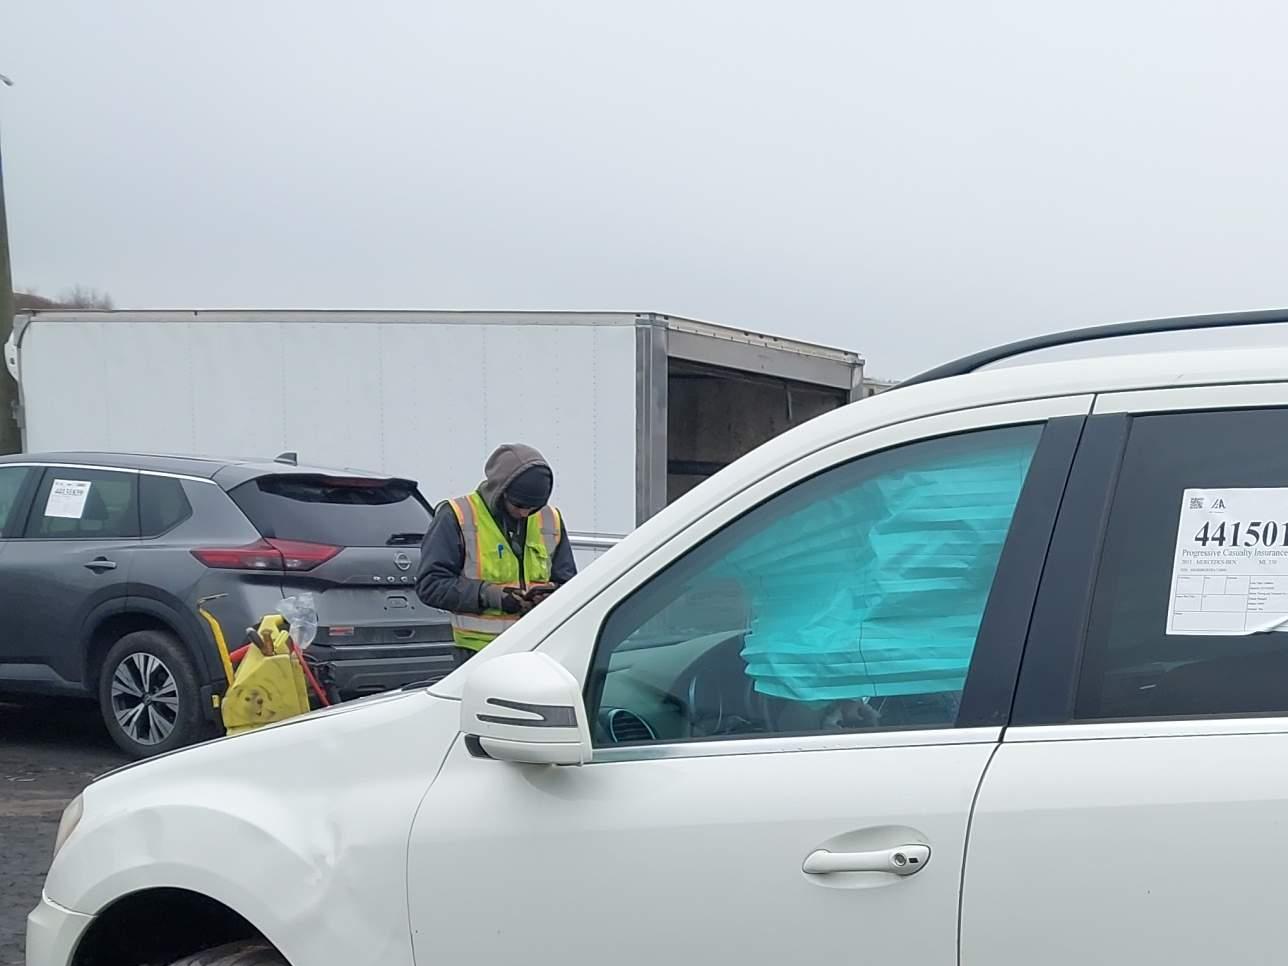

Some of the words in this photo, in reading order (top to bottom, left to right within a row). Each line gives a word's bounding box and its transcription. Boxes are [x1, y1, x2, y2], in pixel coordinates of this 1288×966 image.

[1182, 549, 1221, 559] Progressive
[1223, 548, 1253, 559] Casualty
[1254, 548, 1288, 557] Insurance
